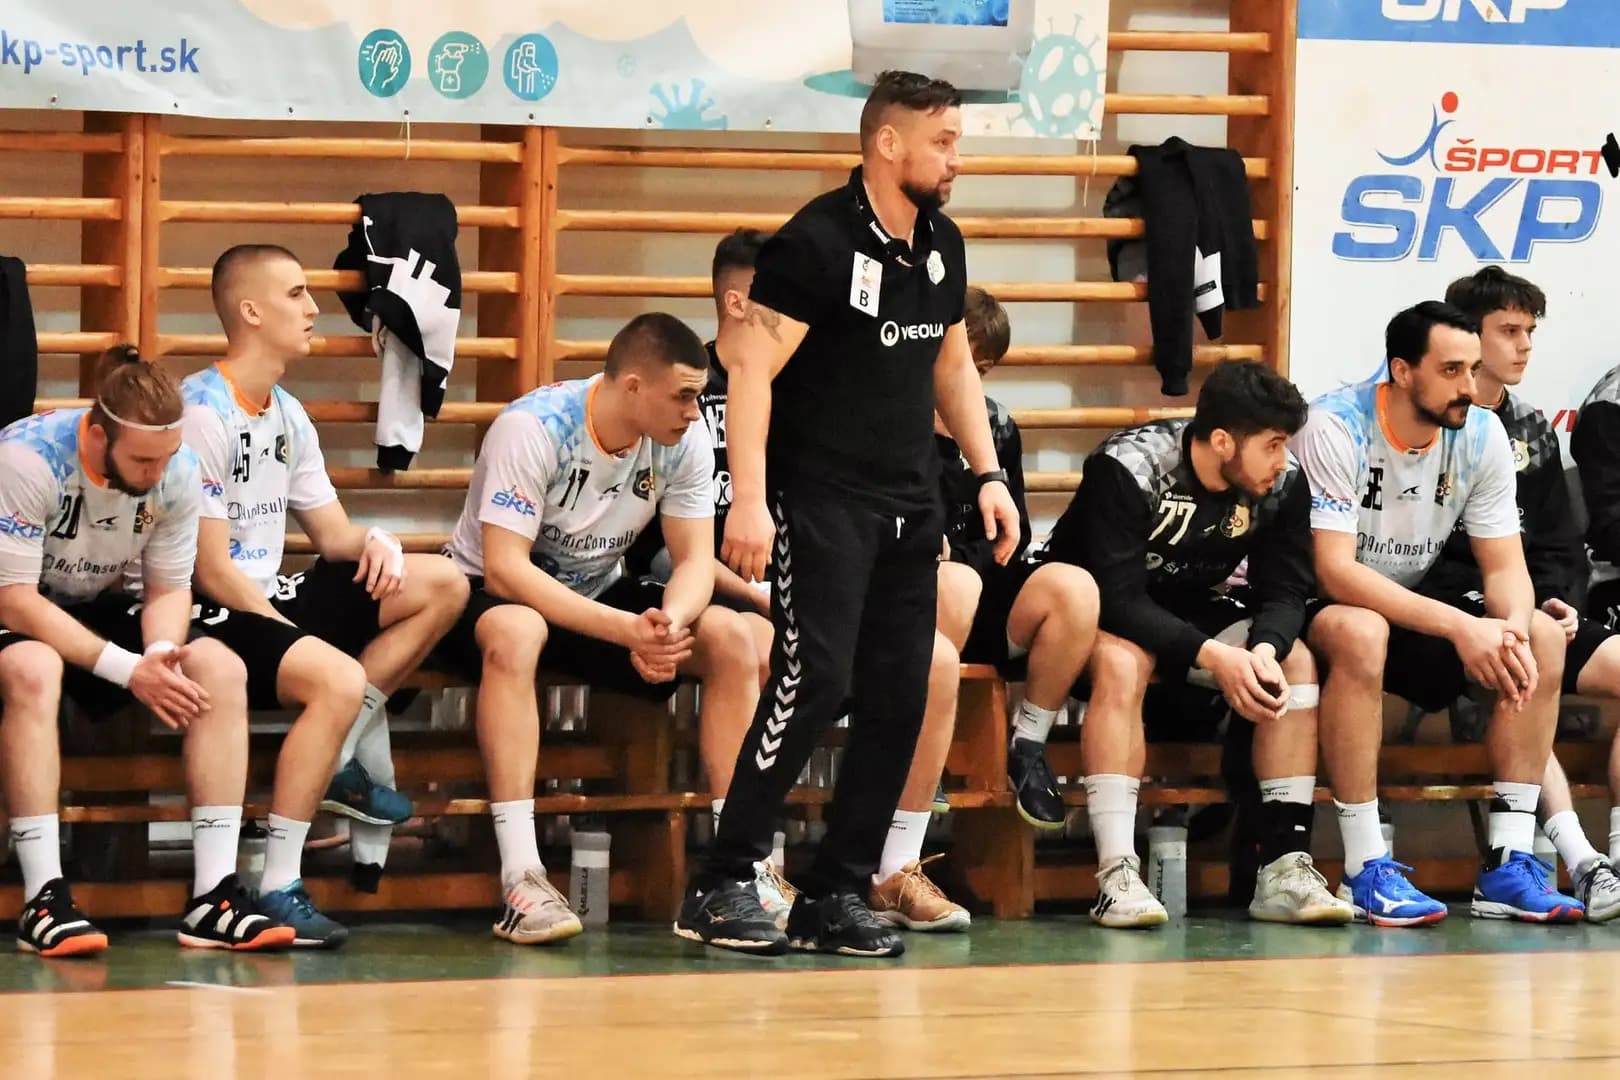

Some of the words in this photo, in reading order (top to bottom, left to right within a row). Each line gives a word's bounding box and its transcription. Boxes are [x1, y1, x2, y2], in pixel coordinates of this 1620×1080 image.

[1444, 138, 1601, 175] ŠPORT
[1331, 174, 1604, 263] SKP
[859, 289, 869, 308] B
[1147, 499, 1198, 546] 77
